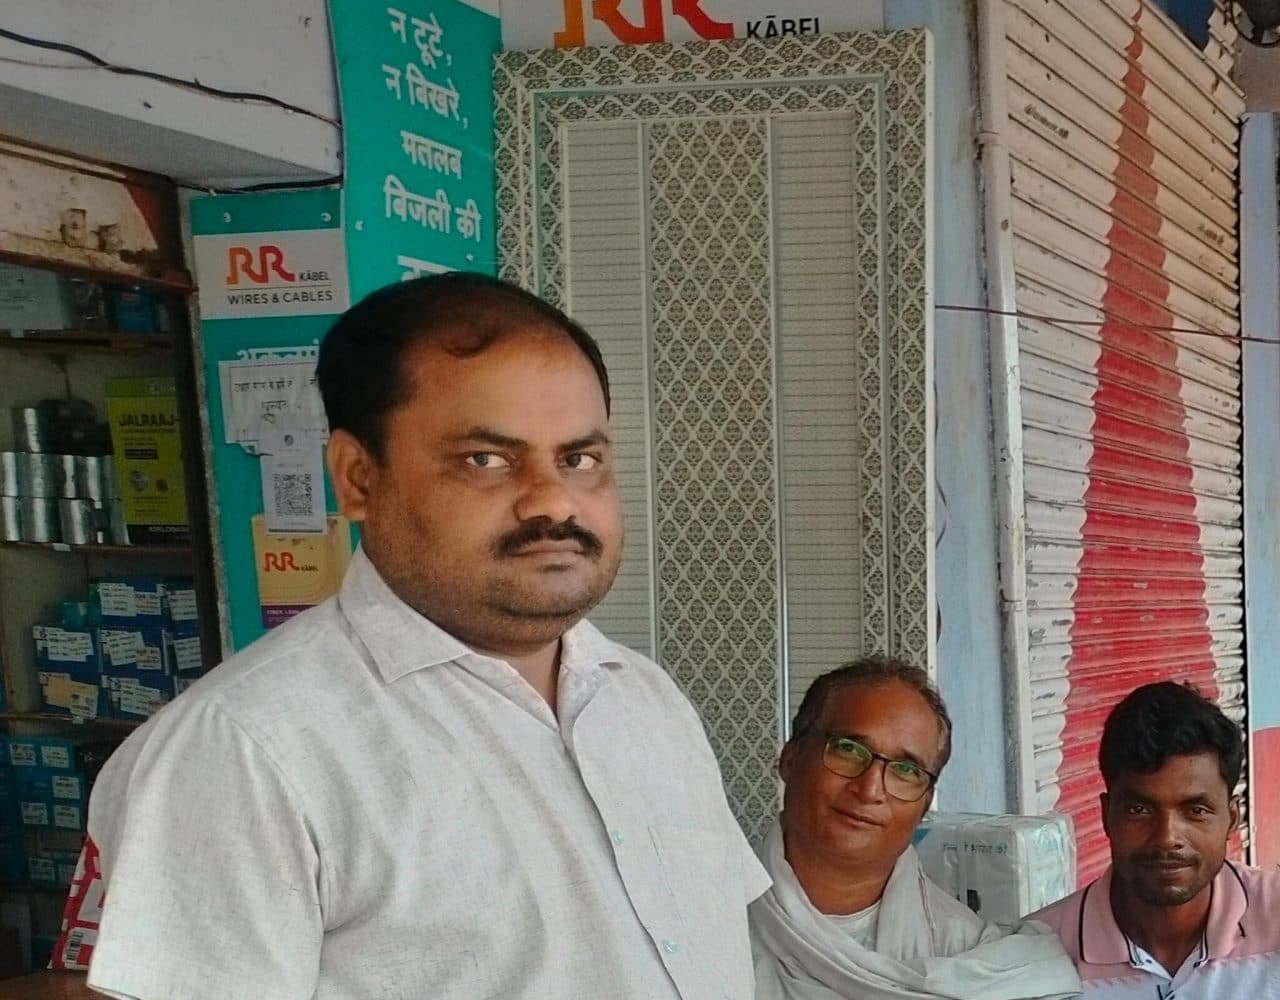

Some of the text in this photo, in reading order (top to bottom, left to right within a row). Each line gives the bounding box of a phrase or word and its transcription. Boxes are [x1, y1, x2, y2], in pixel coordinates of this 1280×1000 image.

[387, 7, 407, 43] न
[382, 63, 401, 100] न
[400, 130, 463, 180] मतलब
[384, 174, 482, 242] बिजली की
[226, 245, 296, 285] RR
[227, 290, 334, 305] WIRES & CABLES
[264, 551, 300, 573] RR
